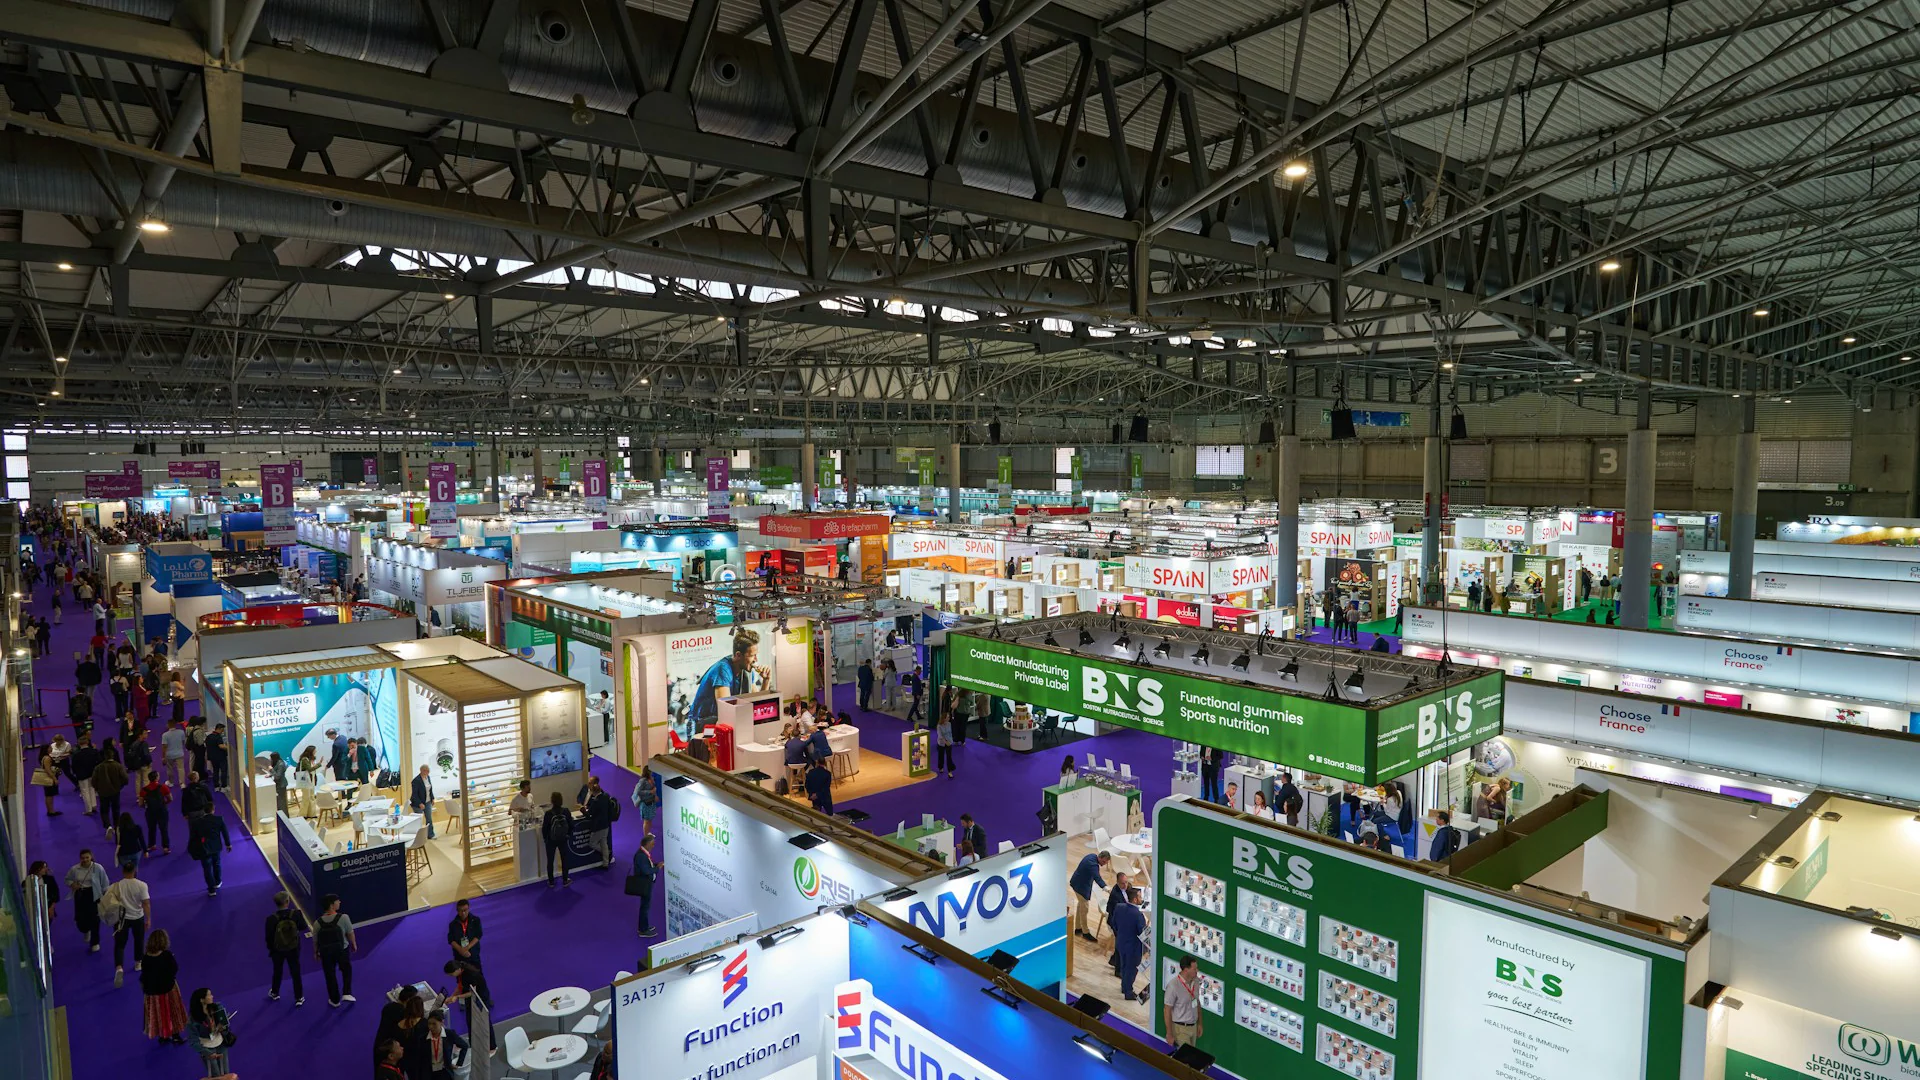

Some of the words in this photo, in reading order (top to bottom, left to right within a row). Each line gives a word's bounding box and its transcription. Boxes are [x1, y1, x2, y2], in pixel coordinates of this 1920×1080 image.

[1598, 448, 1618, 473] 3
[210, 468, 216, 478] C
[368, 466, 372, 475] F
[923, 470, 930, 484] H
[1003, 470, 1008, 483] J
[1074, 466, 1080, 480] K
[1135, 464, 1139, 476] L
[590, 476, 600, 495] D
[714, 472, 722, 490] F
[824, 472, 830, 486] G
[272, 484, 284, 506] B
[438, 480, 448, 500] C
[610, 513, 650, 524] ITALIA
[842, 523, 878, 532] Brefapharm
[172, 570, 208, 578] Pharma
[1129, 562, 1150, 574] NUTRA
[1214, 568, 1230, 578] NUTRA
[672, 636, 712, 650] anona
[1724, 648, 1768, 662] Choose
[970, 648, 1006, 664] Contract
[1006, 656, 1070, 681] Manufacturing
[1724, 658, 1764, 670] France
[1014, 670, 1044, 686] Private
[1046, 676, 1070, 692] Label
[1621, 680, 1657, 690] NUTRITION
[1082, 666, 1164, 717] BNS
[250, 696, 310, 710] NGINEERING
[1180, 690, 1240, 714] Functional
[1243, 704, 1304, 726] gummies
[473, 710, 496, 719] Ideas
[1082, 702, 1101, 713] BOSTON
[1102, 706, 1140, 722] NUTRACEUTICAL
[1142, 716, 1164, 727] SCIENCE
[1180, 706, 1216, 724] Sports
[1218, 716, 1270, 736] nutrition
[1418, 691, 1472, 748] BNS
[1600, 704, 1652, 722] Choose
[250, 716, 300, 729] OLUTIONS
[1600, 717, 1645, 734] France
[1324, 758, 1345, 768] Stand
[1346, 762, 1366, 774] 3B136
[680, 806, 730, 846] Harworld
[1232, 836, 1314, 890] BNS
[1232, 868, 1252, 880] BOSTON
[1252, 874, 1290, 893] NUTRACEUTICAL
[1291, 886, 1314, 900] SCIENCE
[908, 862, 1034, 939] NYO3
[1486, 934, 1559, 965] Manufactured
[1561, 958, 1576, 972] by
[1496, 957, 1563, 998] BNS
[622, 982, 666, 1007] 3A137
[1487, 990, 1508, 1002] your
[1512, 996, 1532, 1010] best
[1534, 1006, 1573, 1025] partner
[684, 1002, 783, 1053] Function
[1484, 1018, 1527, 1038] HEALTHCARE
[1536, 1037, 1570, 1054] IMMUNITY
[1513, 1038, 1538, 1052] BEAUTY
[1512, 1047, 1539, 1061] VITALITY
[1515, 1058, 1534, 1069] SLEEP
[1812, 1054, 1861, 1077] LEADING
